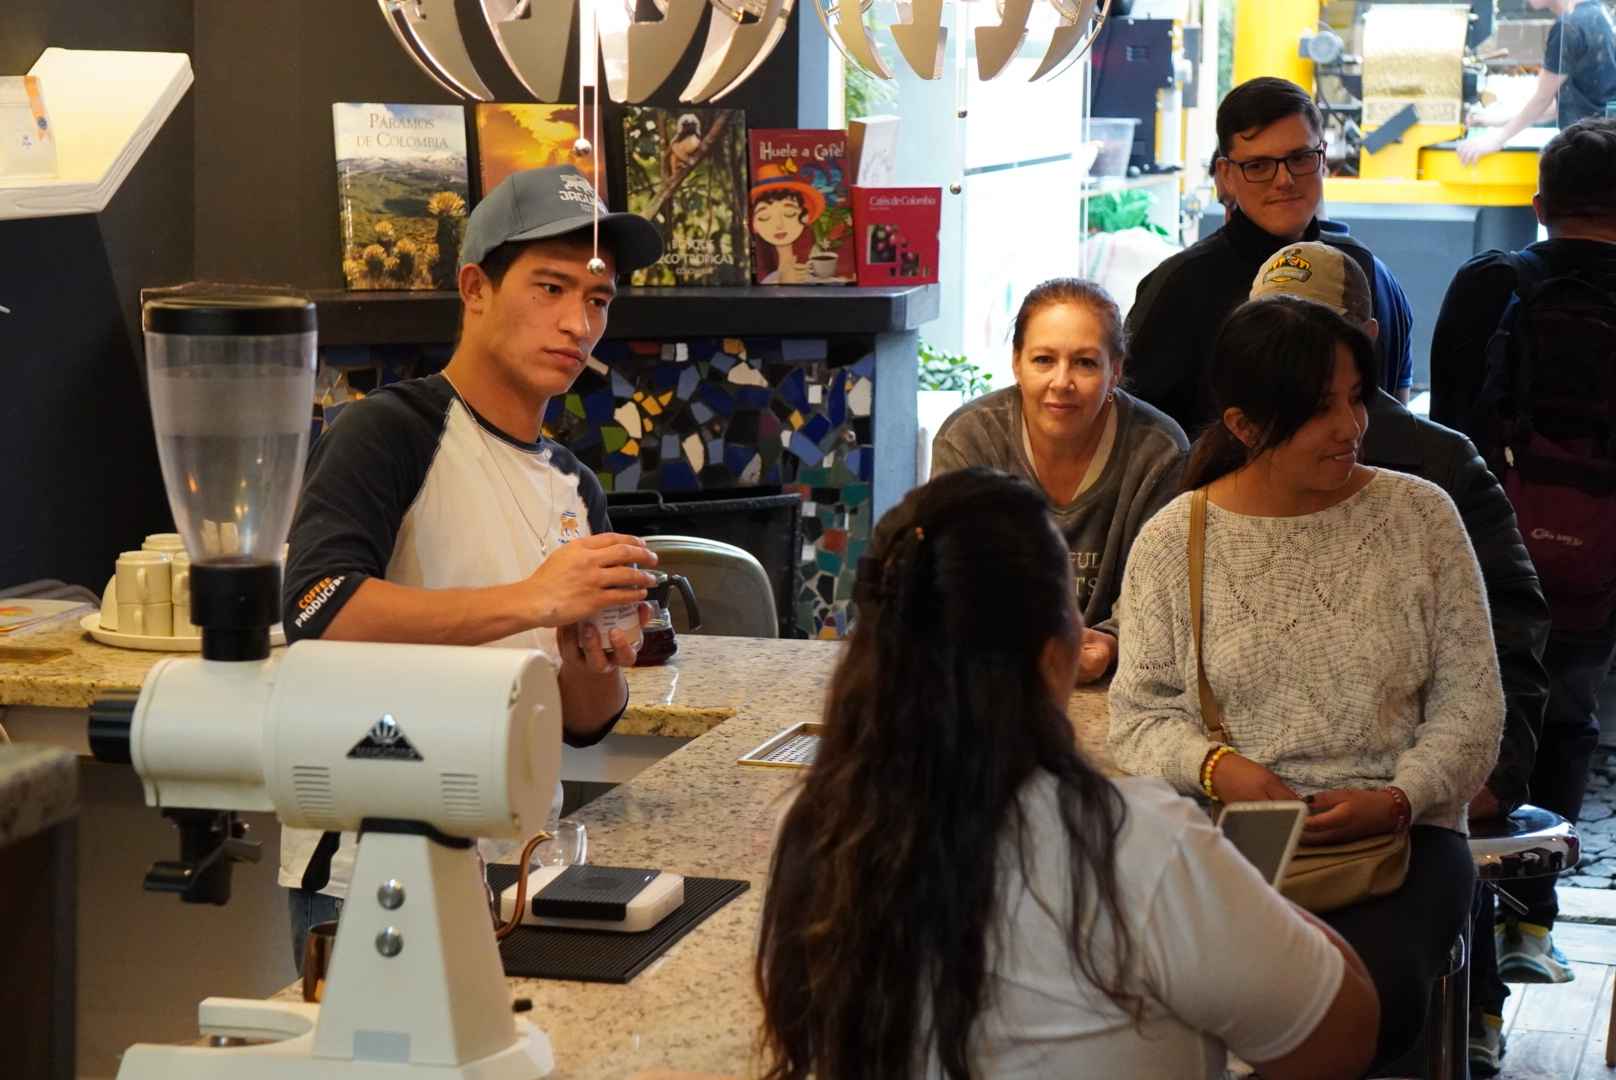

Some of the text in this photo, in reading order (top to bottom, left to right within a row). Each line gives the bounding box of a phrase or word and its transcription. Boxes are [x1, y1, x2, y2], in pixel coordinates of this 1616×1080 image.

[356, 131, 449, 149] DE COLOMBIA
[801, 148, 811, 158] a
[298, 577, 331, 609] COFFEE
